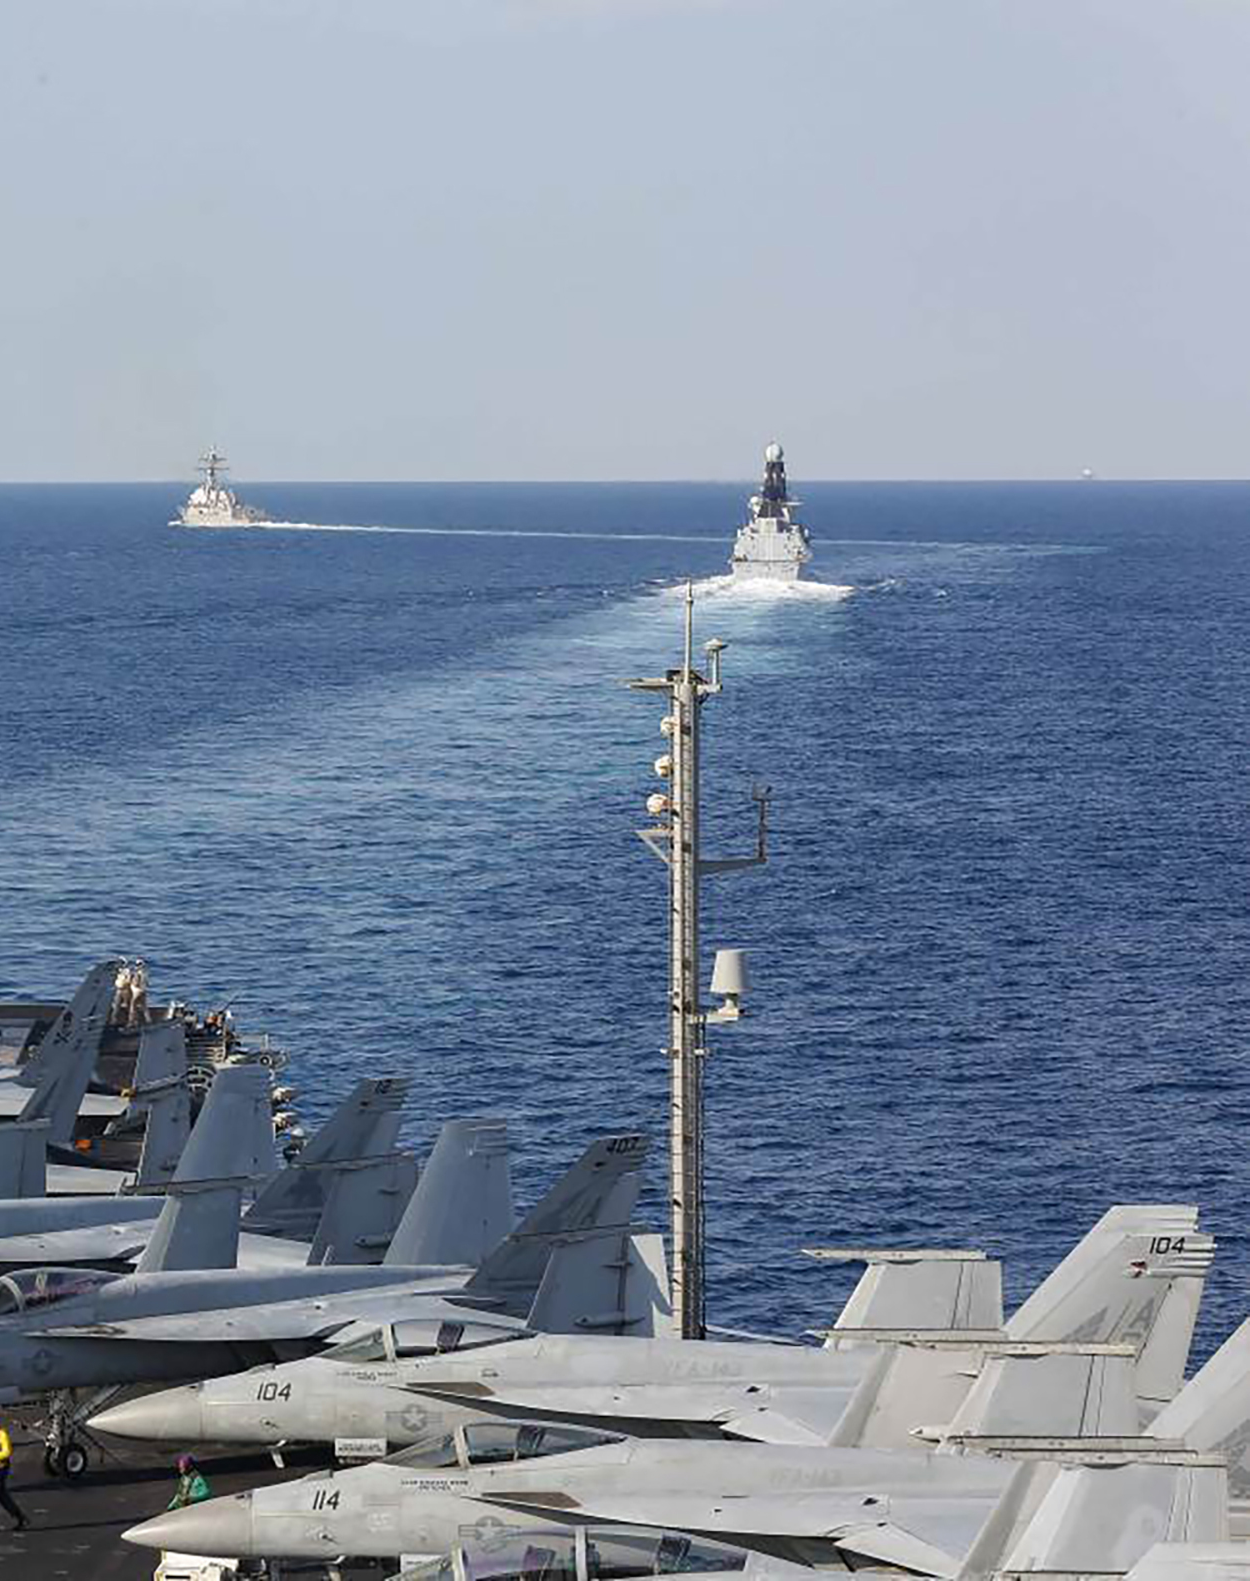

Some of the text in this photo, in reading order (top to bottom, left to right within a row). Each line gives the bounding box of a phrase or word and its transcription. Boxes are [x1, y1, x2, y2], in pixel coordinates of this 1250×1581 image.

[1149, 1236, 1186, 1255] 104
[256, 1382, 292, 1402] 104
[312, 1489, 341, 1511] 114
